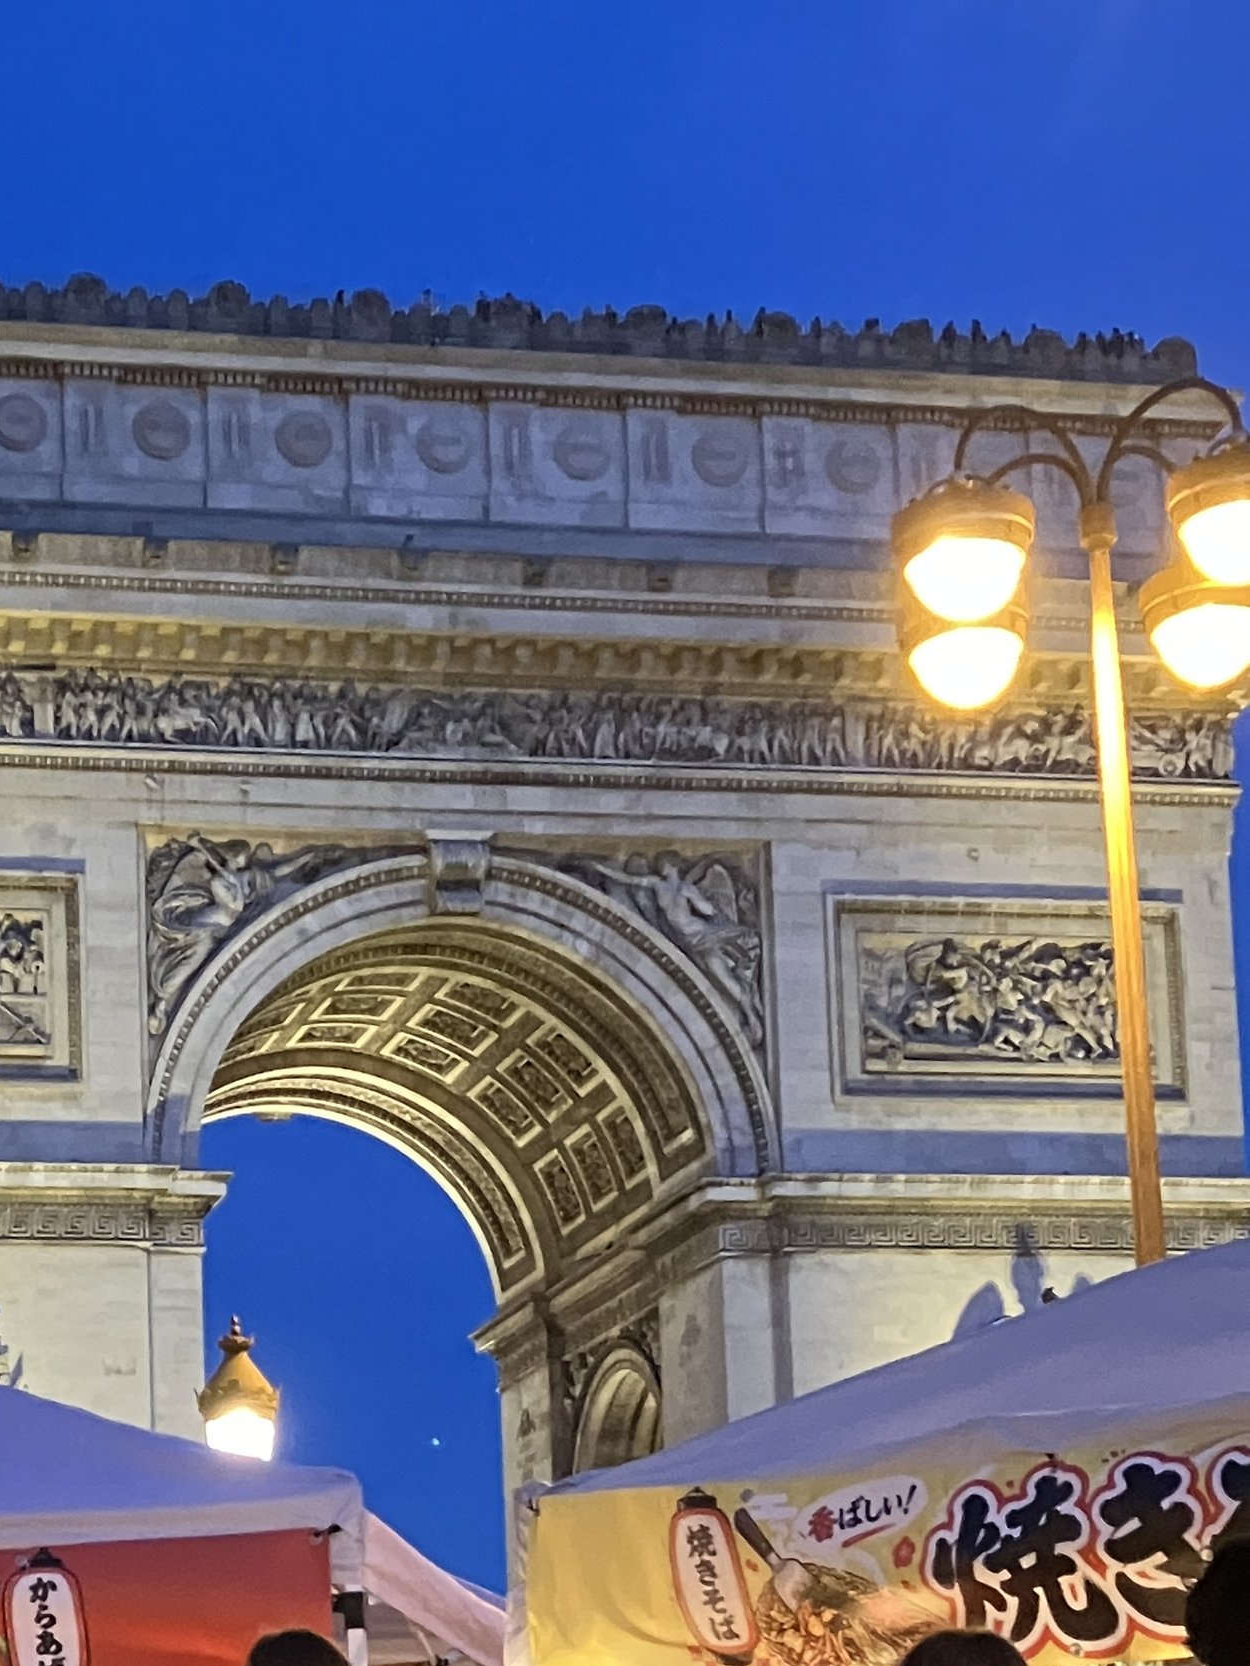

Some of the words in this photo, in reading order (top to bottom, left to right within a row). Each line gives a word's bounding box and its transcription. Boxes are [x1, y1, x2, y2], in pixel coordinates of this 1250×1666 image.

[686, 1523, 741, 1641] 焼きそば
[933, 1459, 1250, 1641] 焼き
